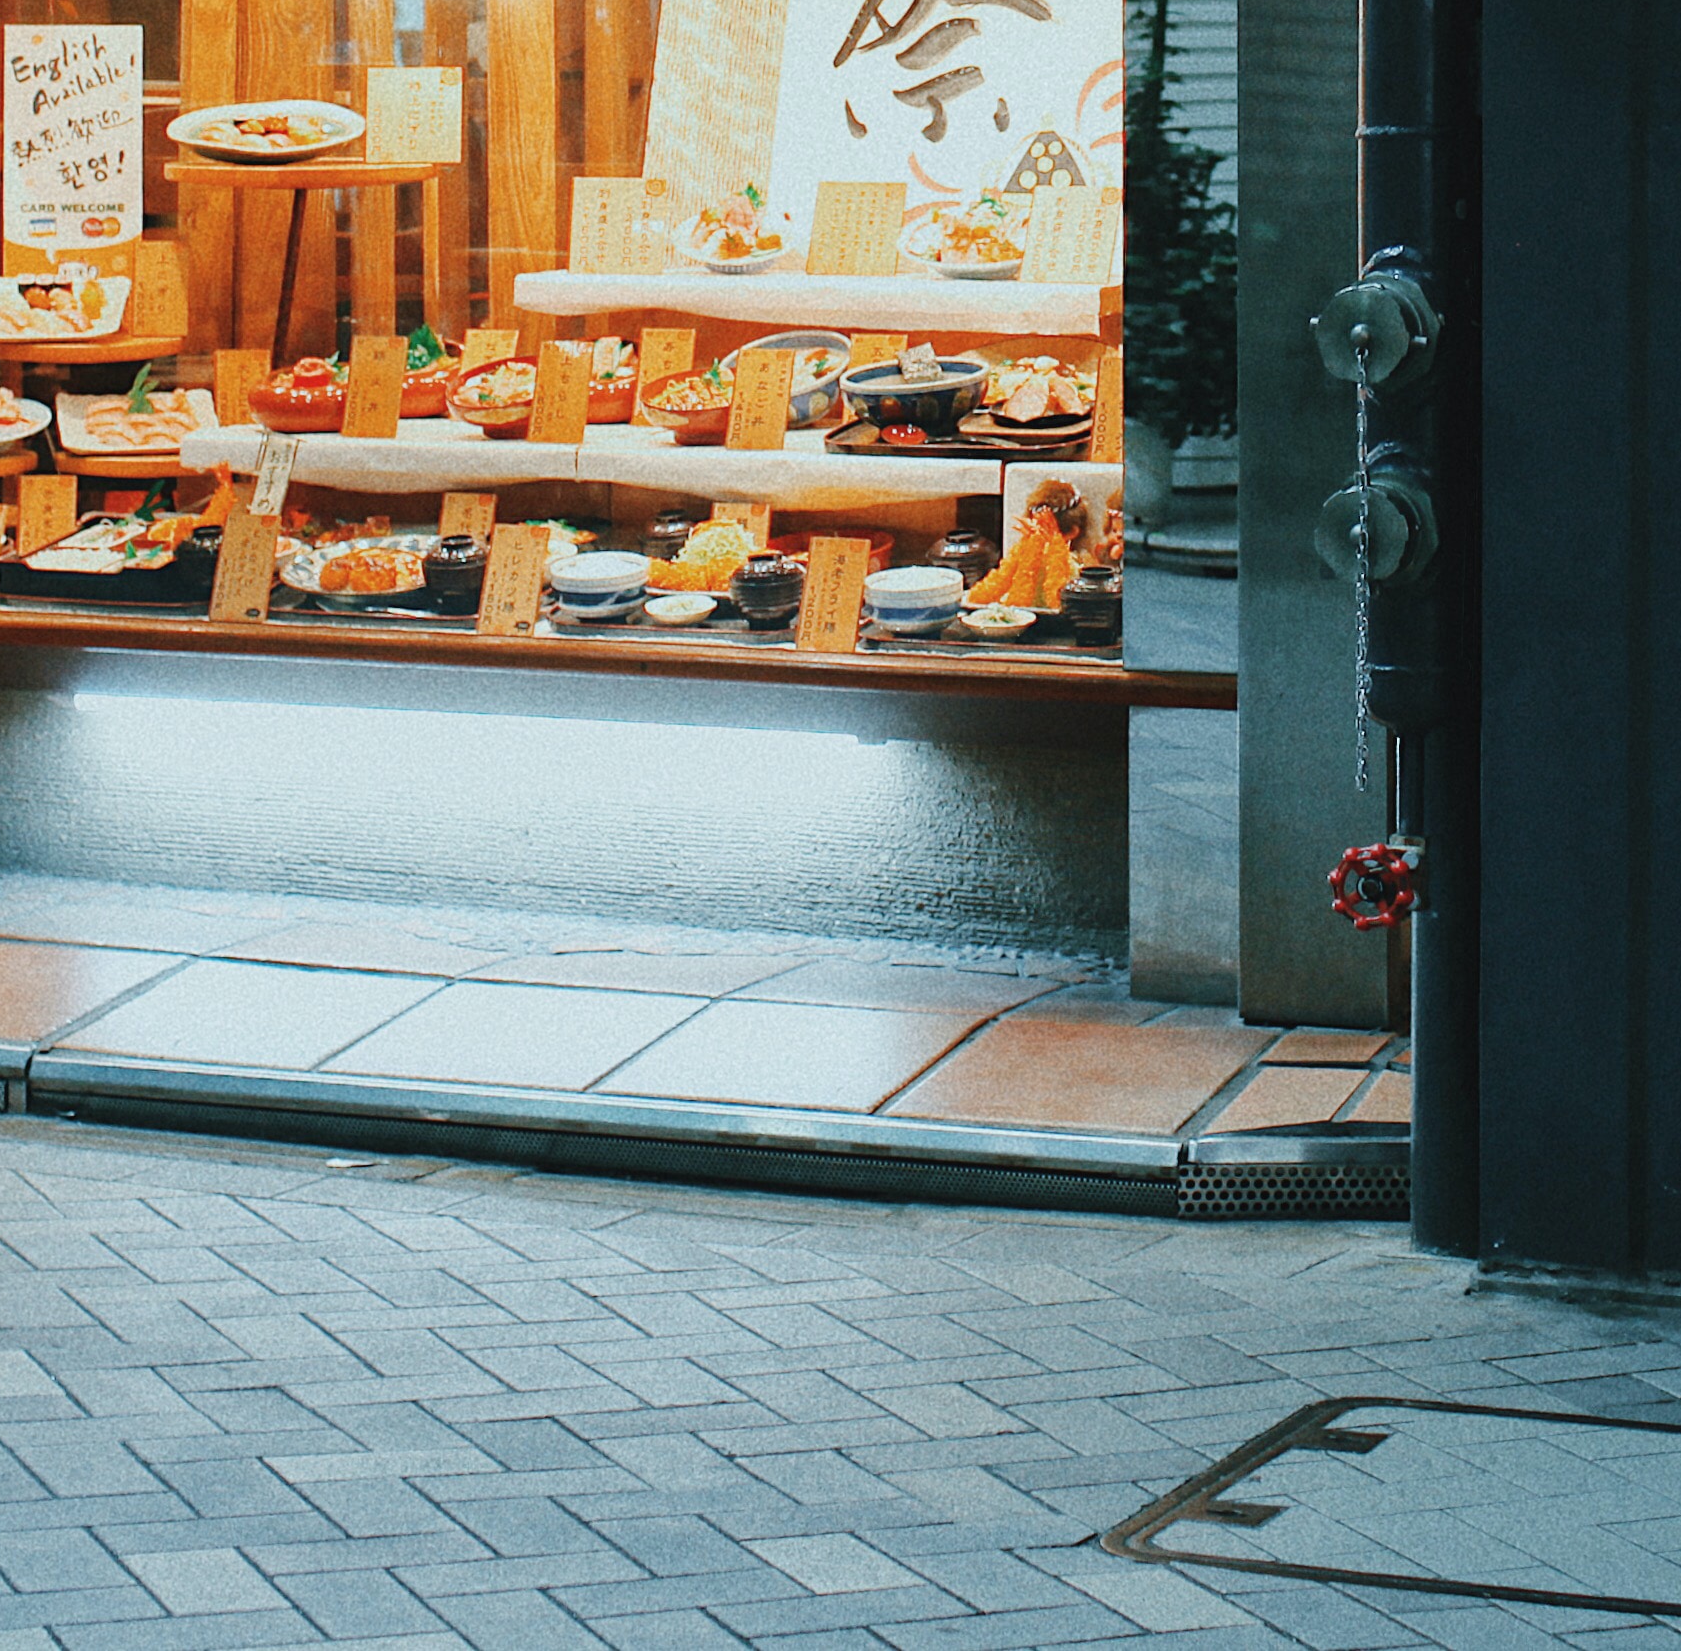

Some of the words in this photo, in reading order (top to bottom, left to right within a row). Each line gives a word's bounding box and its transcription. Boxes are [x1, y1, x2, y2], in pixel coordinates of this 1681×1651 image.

[11, 33, 108, 83] English
[32, 54, 136, 116] Available!
[20, 203, 56, 213] CARD
[61, 203, 126, 213] WELCOME
